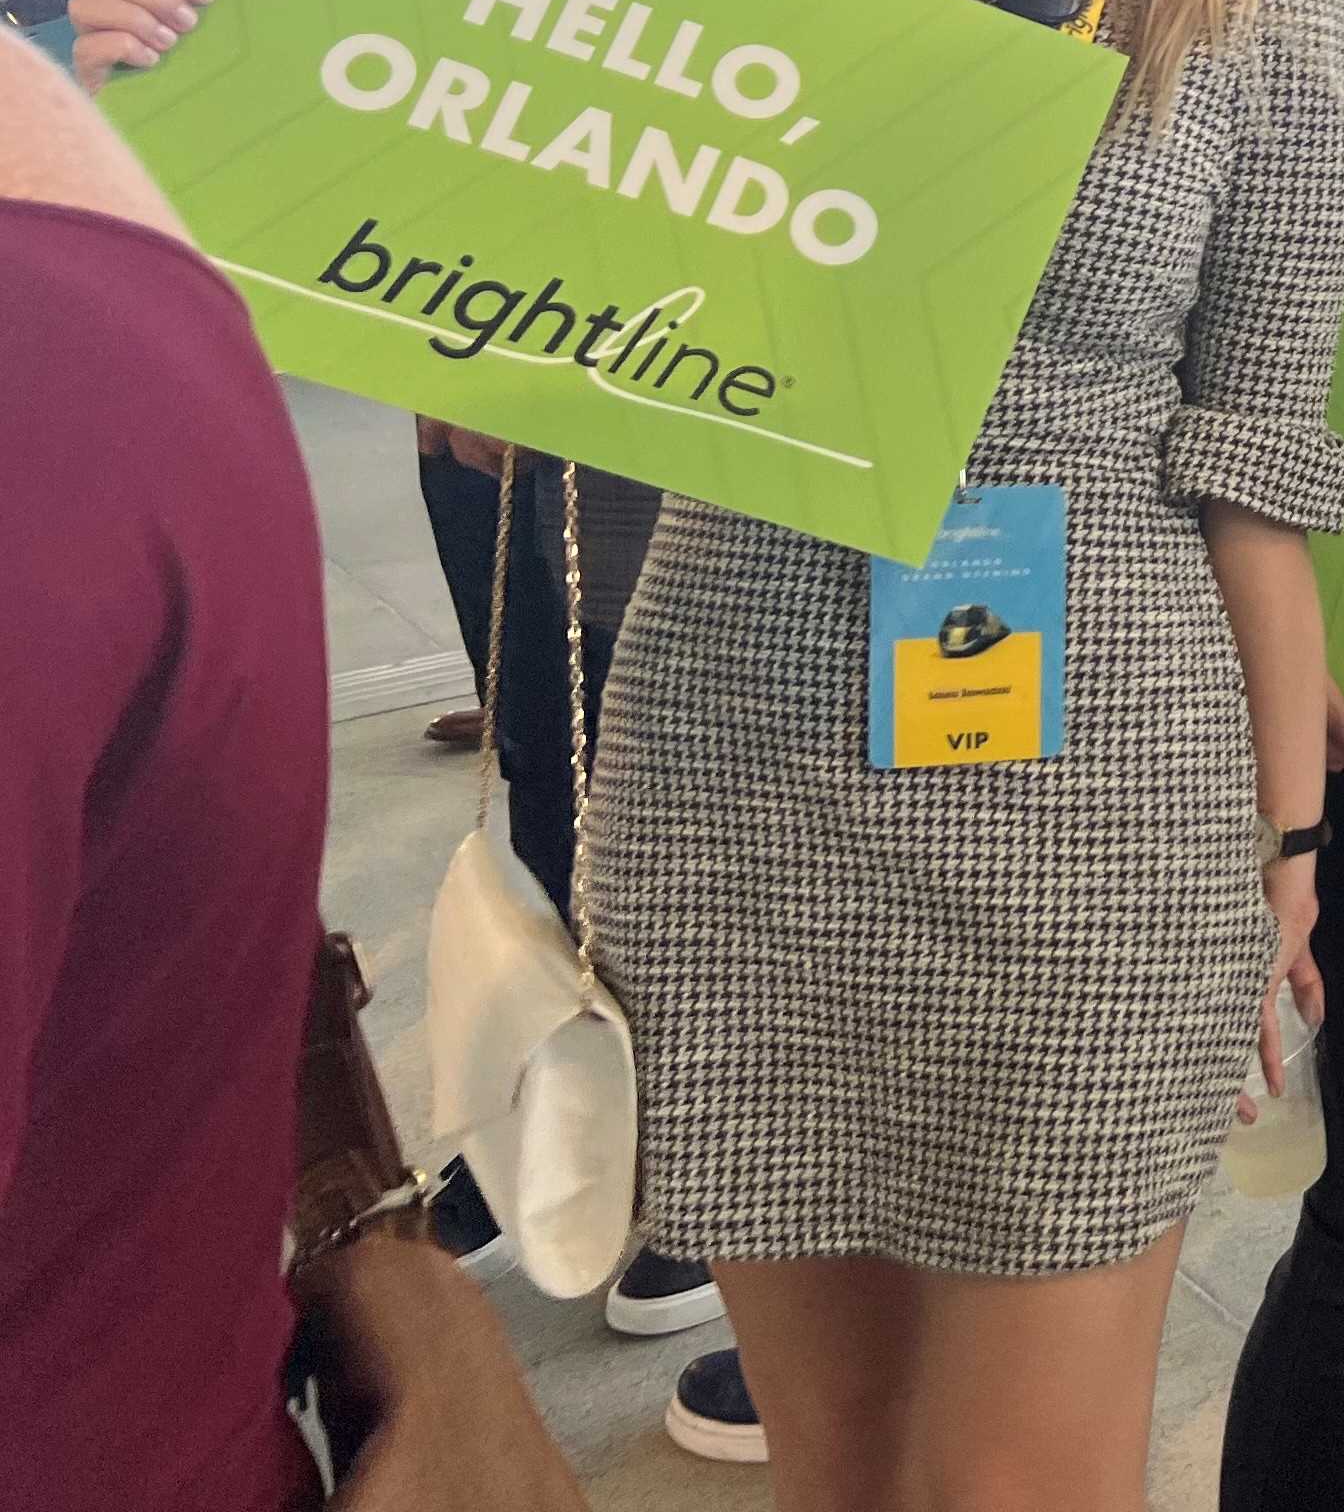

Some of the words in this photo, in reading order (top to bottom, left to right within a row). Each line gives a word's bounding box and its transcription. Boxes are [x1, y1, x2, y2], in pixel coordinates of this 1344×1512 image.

[319, 32, 880, 265] ORLANDO
[317, 218, 782, 417] brightline
[947, 732, 990, 751] VIP
